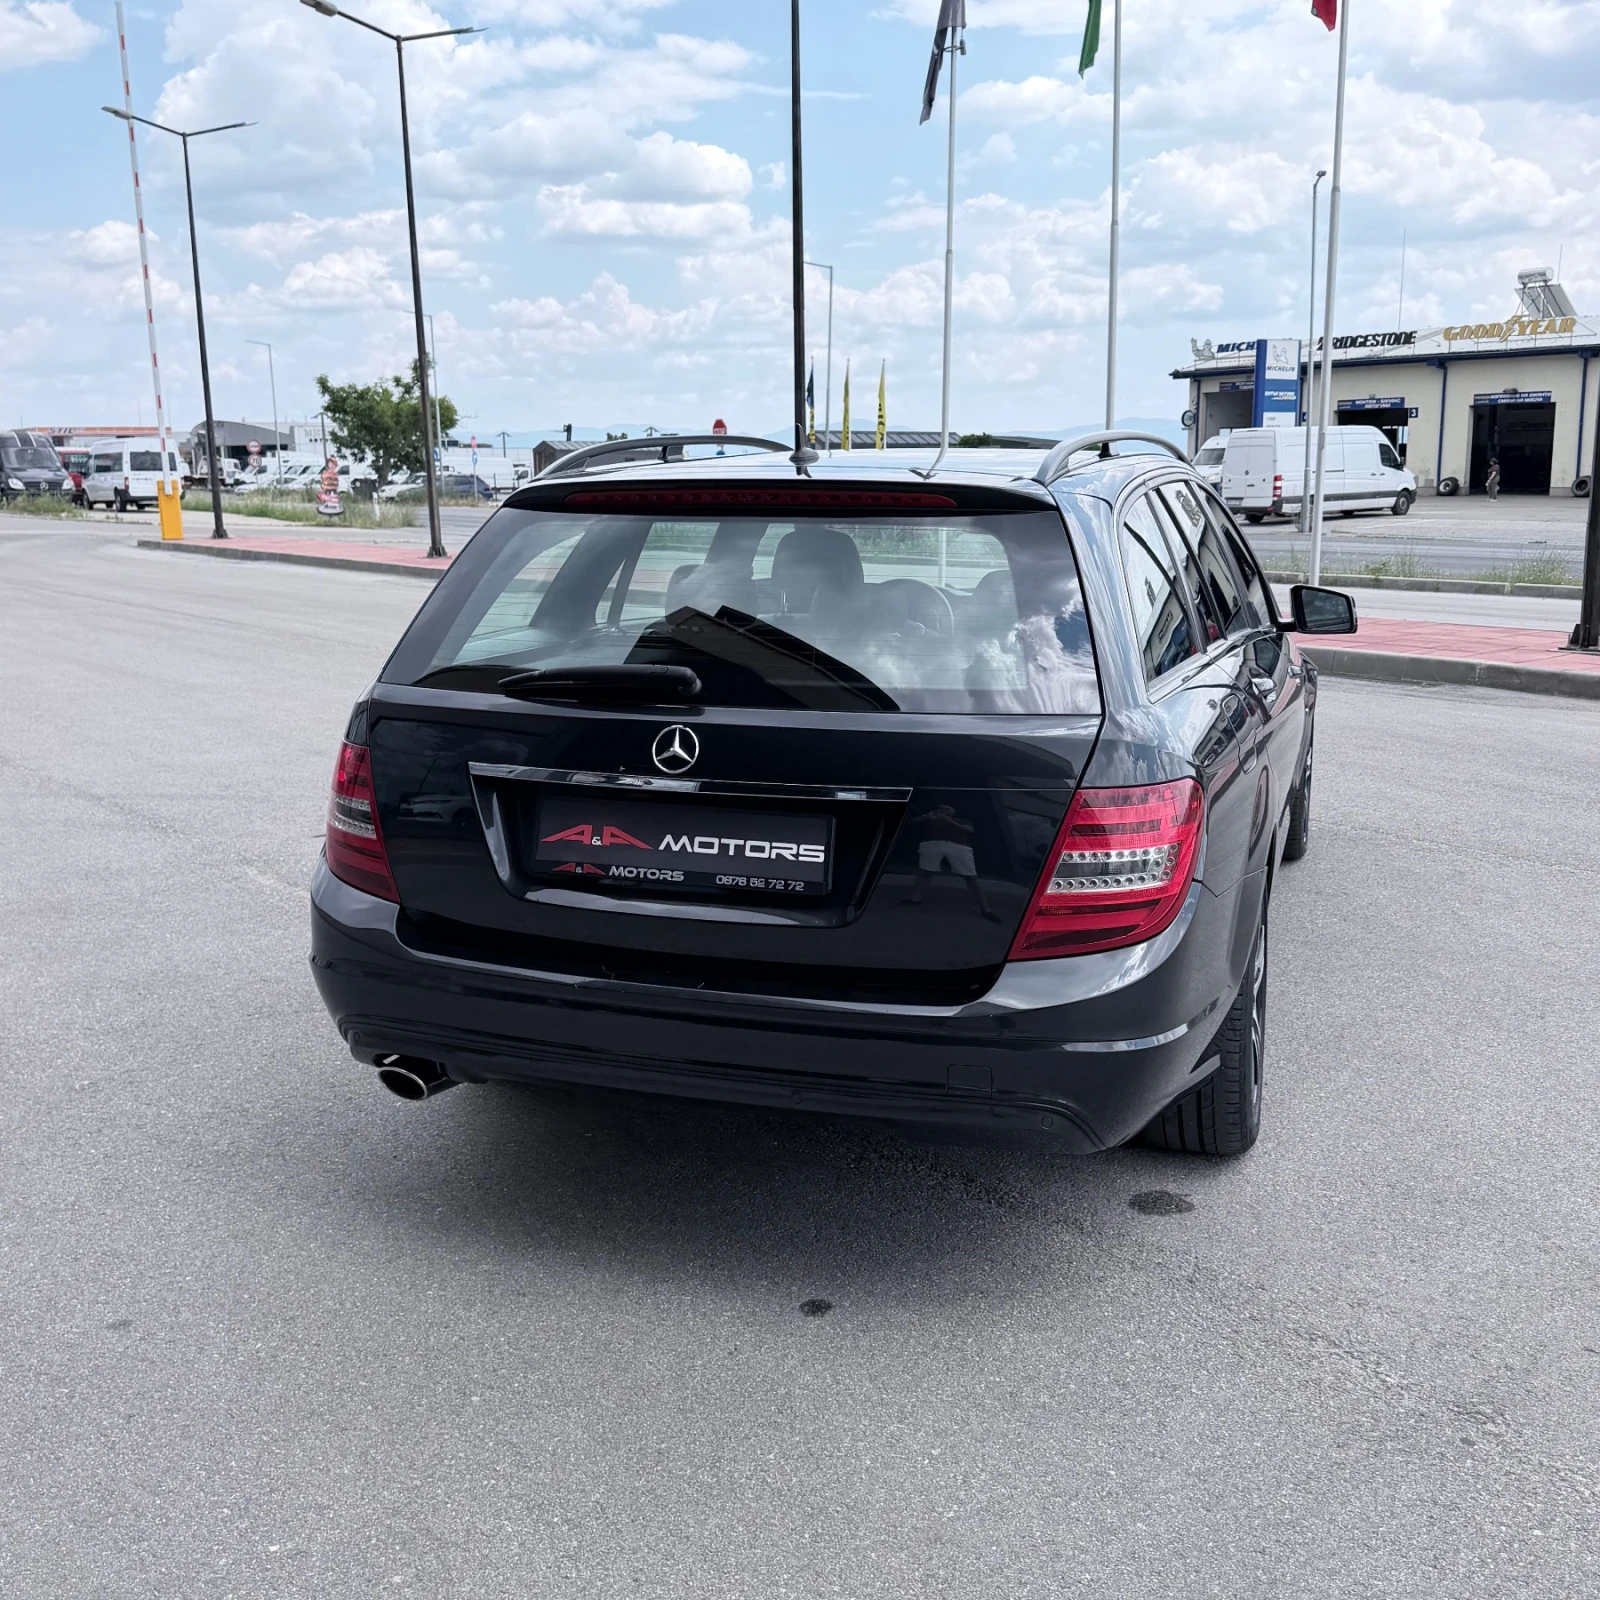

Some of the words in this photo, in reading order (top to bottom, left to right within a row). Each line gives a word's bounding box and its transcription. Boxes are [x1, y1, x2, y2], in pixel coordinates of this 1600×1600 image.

[1443, 317, 1576, 341] GOODYEAR
[1217, 341, 1257, 353] MICH
[541, 824, 653, 850] A&A
[658, 834, 825, 863] MOTORS
[552, 862, 606, 876] A&A
[608, 865, 685, 882] MOTORS
[767, 879, 784, 889] 72
[787, 880, 804, 891] 72
